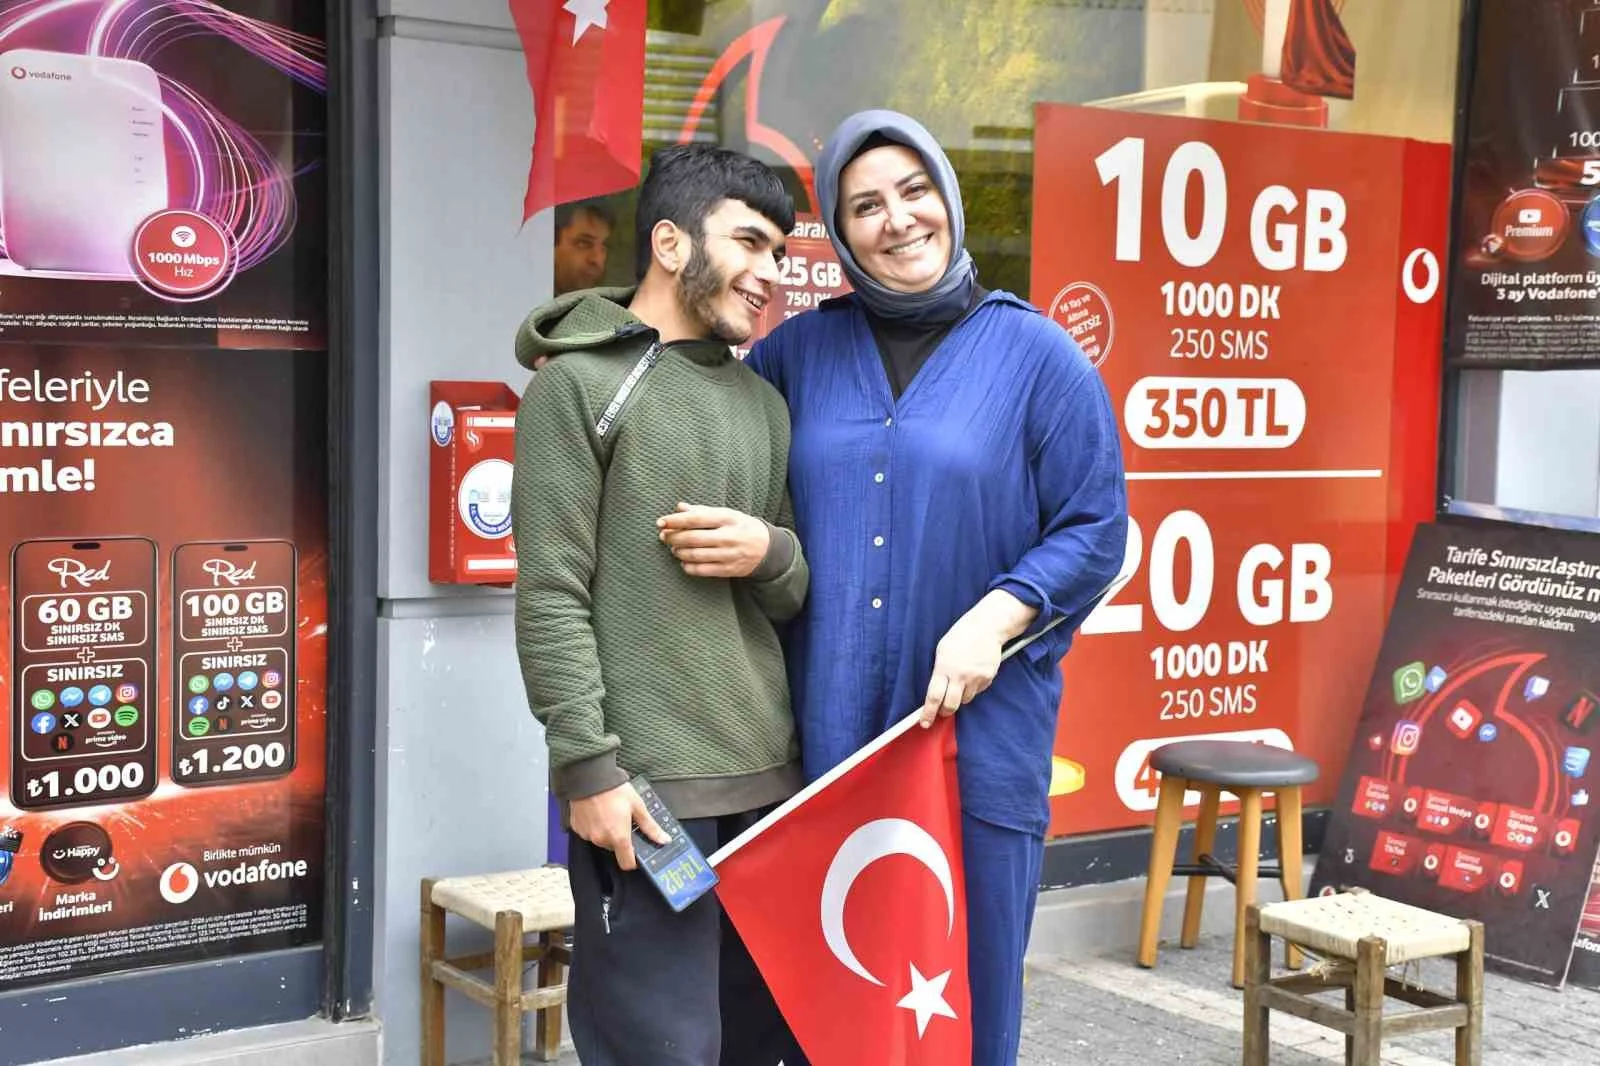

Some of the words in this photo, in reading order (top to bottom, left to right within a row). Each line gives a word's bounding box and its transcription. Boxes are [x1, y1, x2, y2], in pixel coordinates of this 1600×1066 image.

[28, 70, 72, 80] vodafone
[1094, 136, 1227, 267] 10
[1250, 184, 1348, 272] GB
[1504, 224, 1553, 238] Premium
[148, 252, 182, 264] 1000
[184, 252, 220, 267] Mbps
[174, 268, 194, 278] Hız
[777, 256, 808, 286] 25
[811, 262, 842, 288] GB
[1481, 272, 1520, 287] Dijital
[1522, 272, 1584, 287] platform
[785, 291, 812, 306] 750
[1160, 281, 1234, 318] 1000
[1239, 284, 1281, 320] DK
[1496, 288, 1506, 300] 3
[1507, 289, 1526, 303] ay
[1170, 328, 1215, 359] 250
[1220, 330, 1268, 360] SMS
[0, 368, 150, 411] feleriyle
[1144, 386, 1227, 439] 350
[1237, 387, 1289, 437] TL
[1, 420, 174, 447] nırsızca
[0, 458, 96, 492] mle!
[1447, 546, 1488, 566] Tarife
[47, 558, 112, 589] Red
[202, 558, 256, 586] Red
[1080, 510, 1214, 635] 20
[1237, 543, 1333, 626] GB
[1428, 566, 1497, 588] Paketleri
[1498, 573, 1586, 601] Gördünüz
[38, 597, 82, 624] 60
[87, 595, 133, 621] GB
[186, 594, 240, 616] 100
[244, 591, 284, 614] GB
[50, 622, 102, 634] SINIRSIZ
[104, 621, 120, 632] DK
[200, 625, 244, 637] SINIRSIZ
[246, 624, 268, 635] SMS
[204, 616, 248, 626] SINIRSIZ
[250, 615, 264, 625] DK
[46, 633, 100, 646] SINIRSIZ
[100, 632, 124, 643] SMS
[200, 653, 268, 669] SINIRSIZ
[1150, 642, 1222, 680] 1000
[1227, 639, 1269, 674] DK
[47, 664, 124, 682] SINIRSIZ
[1160, 688, 1204, 720] 250
[1210, 684, 1257, 715] SMS
[67, 846, 101, 858] Happy
[203, 848, 236, 862] Birlikte
[238, 842, 280, 858] mümkün
[203, 859, 308, 888] vodafone
[56, 892, 96, 906] Marka
[39, 900, 112, 922] İndirimleri
